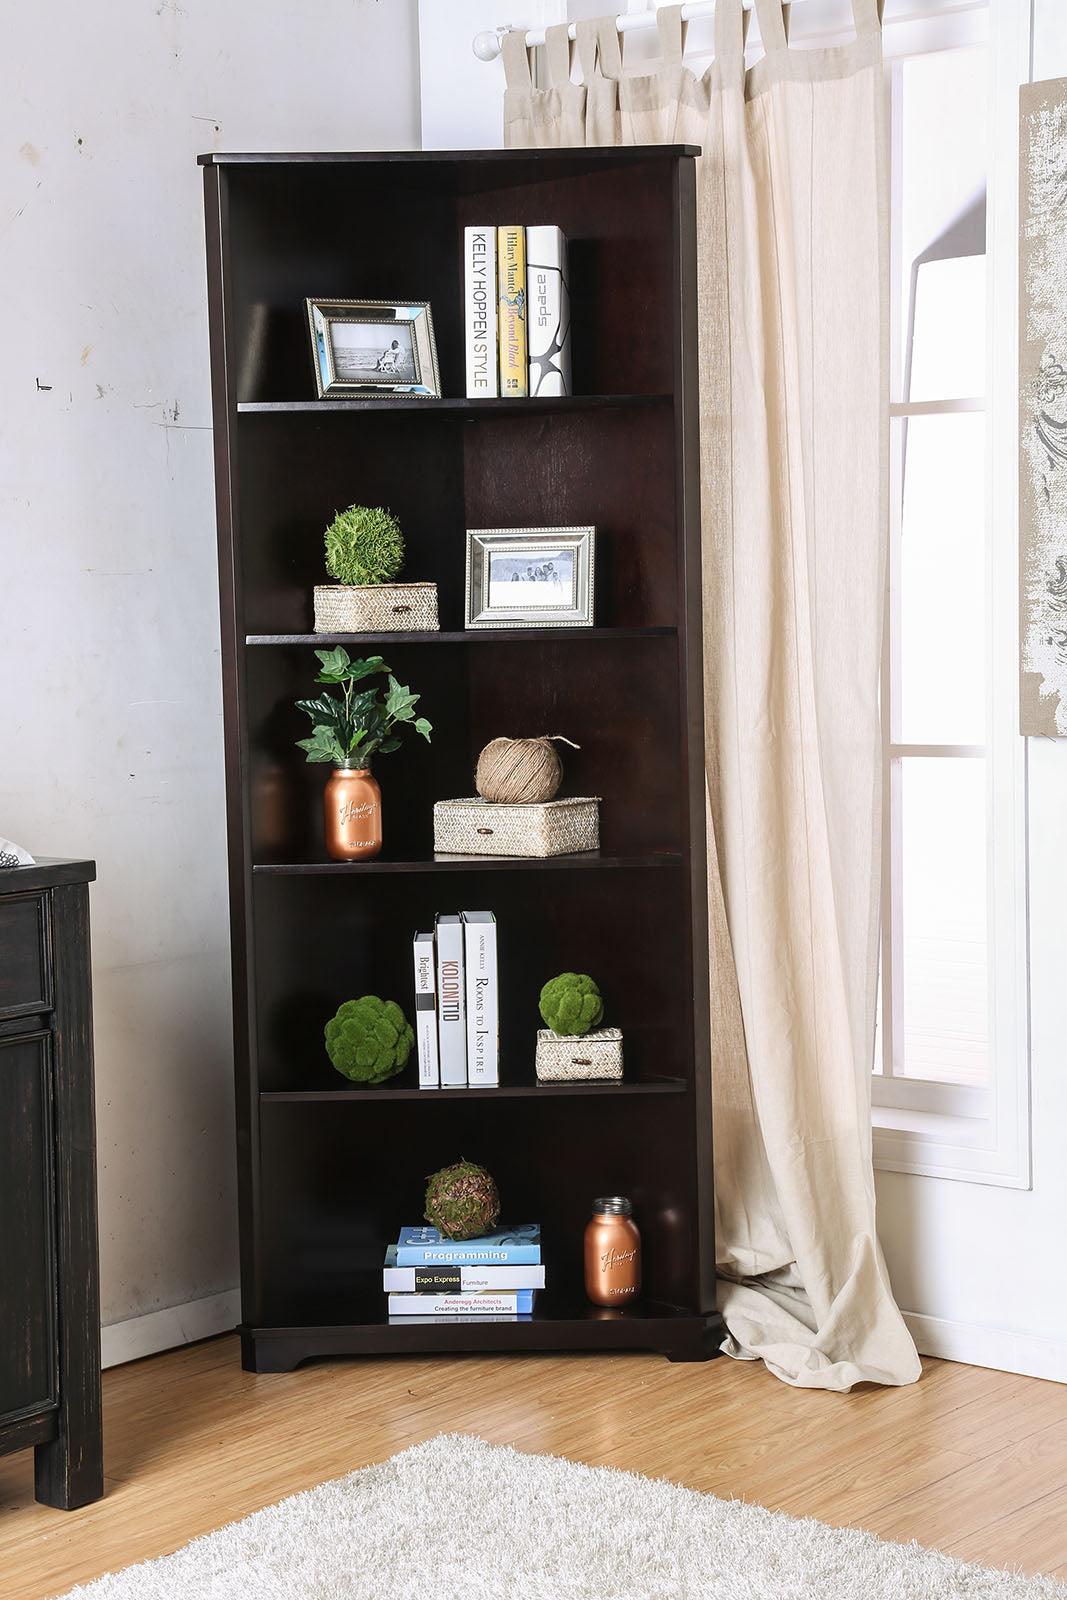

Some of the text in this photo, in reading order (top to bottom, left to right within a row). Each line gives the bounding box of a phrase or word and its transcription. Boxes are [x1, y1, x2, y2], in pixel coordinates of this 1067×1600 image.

[504, 232, 518, 294] Hilary Mantel
[472, 234, 487, 387] KELLY HOPPEN STYLE
[538, 275, 551, 326] space
[506, 308, 518, 341] Beyond
[508, 342, 519, 368] Black
[418, 957, 429, 990] Brightest
[442, 961, 459, 1021] KOLONITID
[424, 1250, 507, 1260] Programming
